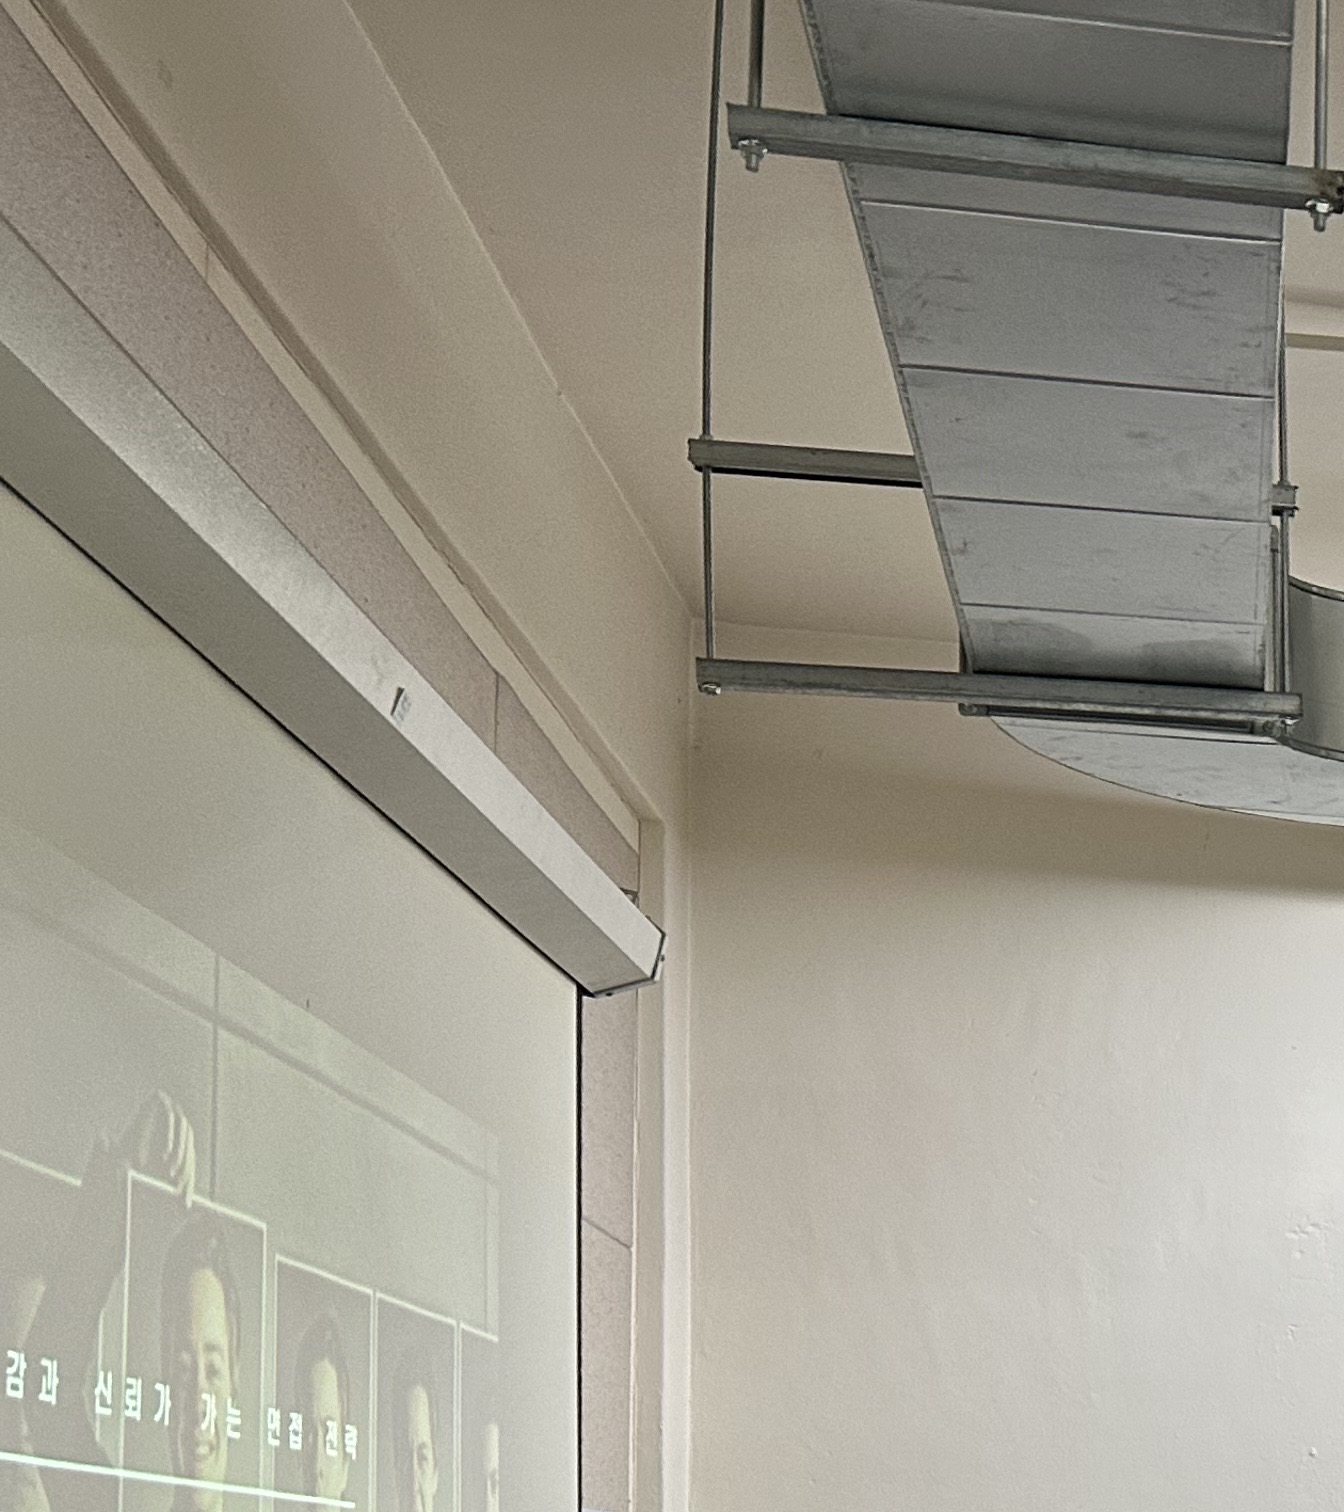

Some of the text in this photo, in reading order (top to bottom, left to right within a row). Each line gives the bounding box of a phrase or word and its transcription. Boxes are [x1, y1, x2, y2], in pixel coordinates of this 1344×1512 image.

[5, 1349, 60, 1406] 감과
[94, 1370, 172, 1426] 신뢰가
[200, 1391, 242, 1440] 가는
